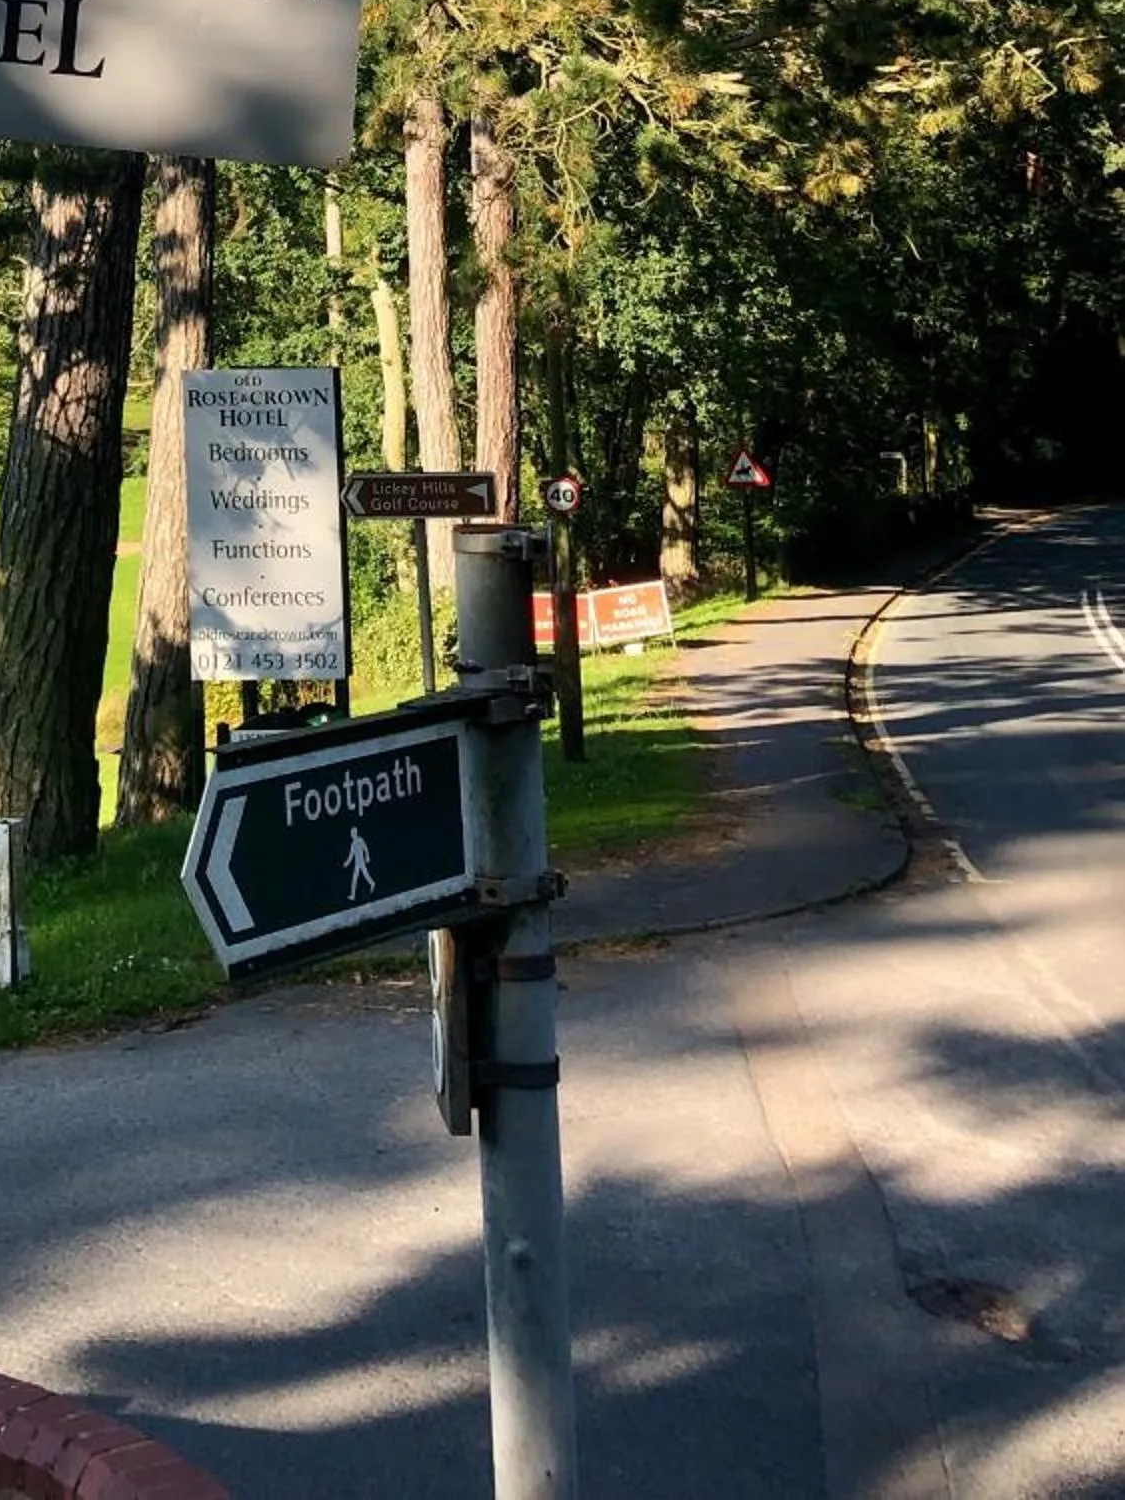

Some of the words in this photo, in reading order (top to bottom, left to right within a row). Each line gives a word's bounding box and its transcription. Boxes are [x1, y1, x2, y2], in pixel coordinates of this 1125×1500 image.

[234, 375, 263, 387] OLD
[219, 408, 289, 428] HOTEL
[208, 442, 309, 463] Bedrooms
[372, 482, 417, 496] Lickey
[422, 481, 457, 495] Hills
[550, 489, 574, 502] 40
[211, 490, 310, 515] Weddings
[370, 497, 403, 511] Golf
[408, 498, 459, 511] Course
[212, 539, 312, 560] Functions
[202, 587, 325, 608] Conferences
[198, 653, 243, 670] 0121
[251, 652, 284, 670] 453
[285, 755, 422, 827] Footpath
